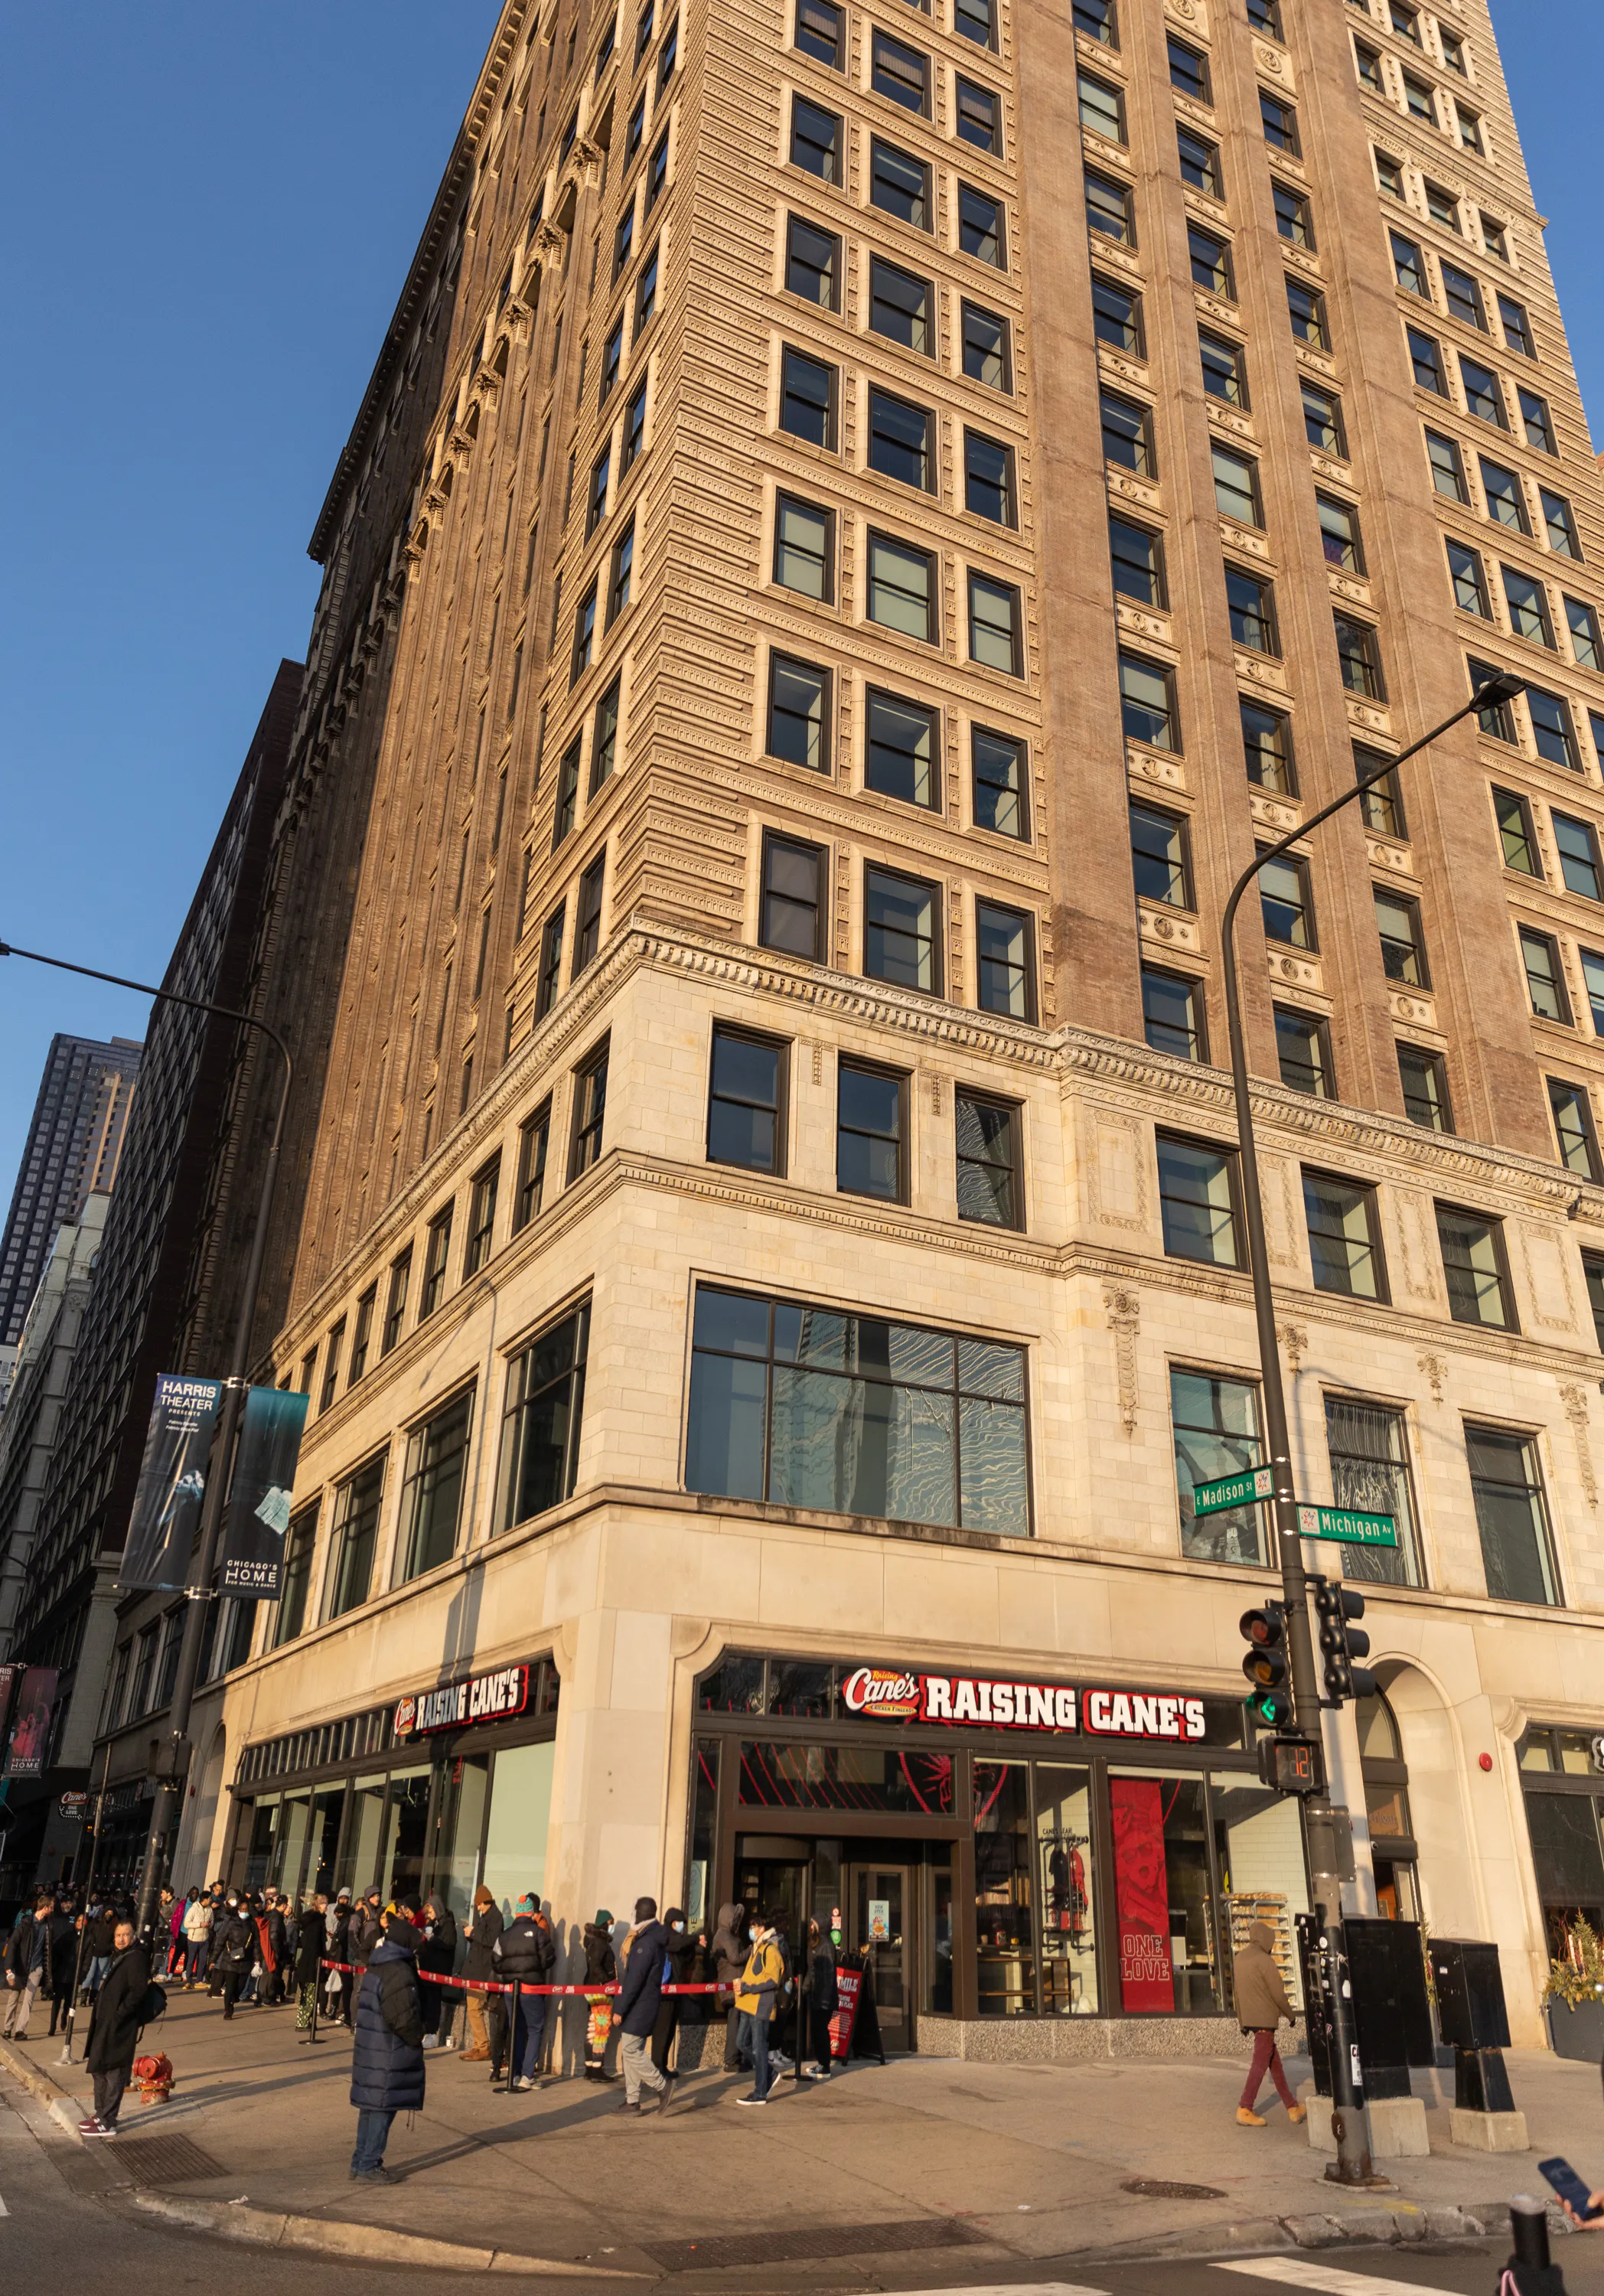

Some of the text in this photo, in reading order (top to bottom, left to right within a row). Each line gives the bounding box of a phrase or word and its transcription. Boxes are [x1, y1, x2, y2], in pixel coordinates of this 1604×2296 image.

[162, 1381, 217, 1399] HARRIS
[161, 1394, 214, 1411] THEATER
[168, 1408, 201, 1417] PRESENTS
[1196, 1482, 1253, 1507] E Madison St
[1322, 1512, 1391, 1540] Michigan Av
[227, 1559, 278, 1571] CHICAGO'S
[225, 1567, 277, 1584] HOME
[872, 1670, 898, 1682] Raising
[416, 1683, 467, 1730] RAISING
[469, 1668, 520, 1717] CANE'S
[846, 1668, 1205, 1738] Cane's RAISING CANE'S
[11, 1762, 39, 1771] HOME
[1295, 1747, 1309, 1778] 12
[61, 1791, 87, 1805] Cane's
[1123, 1934, 1163, 1957] ONE
[1120, 1958, 1170, 1981] LOVE
